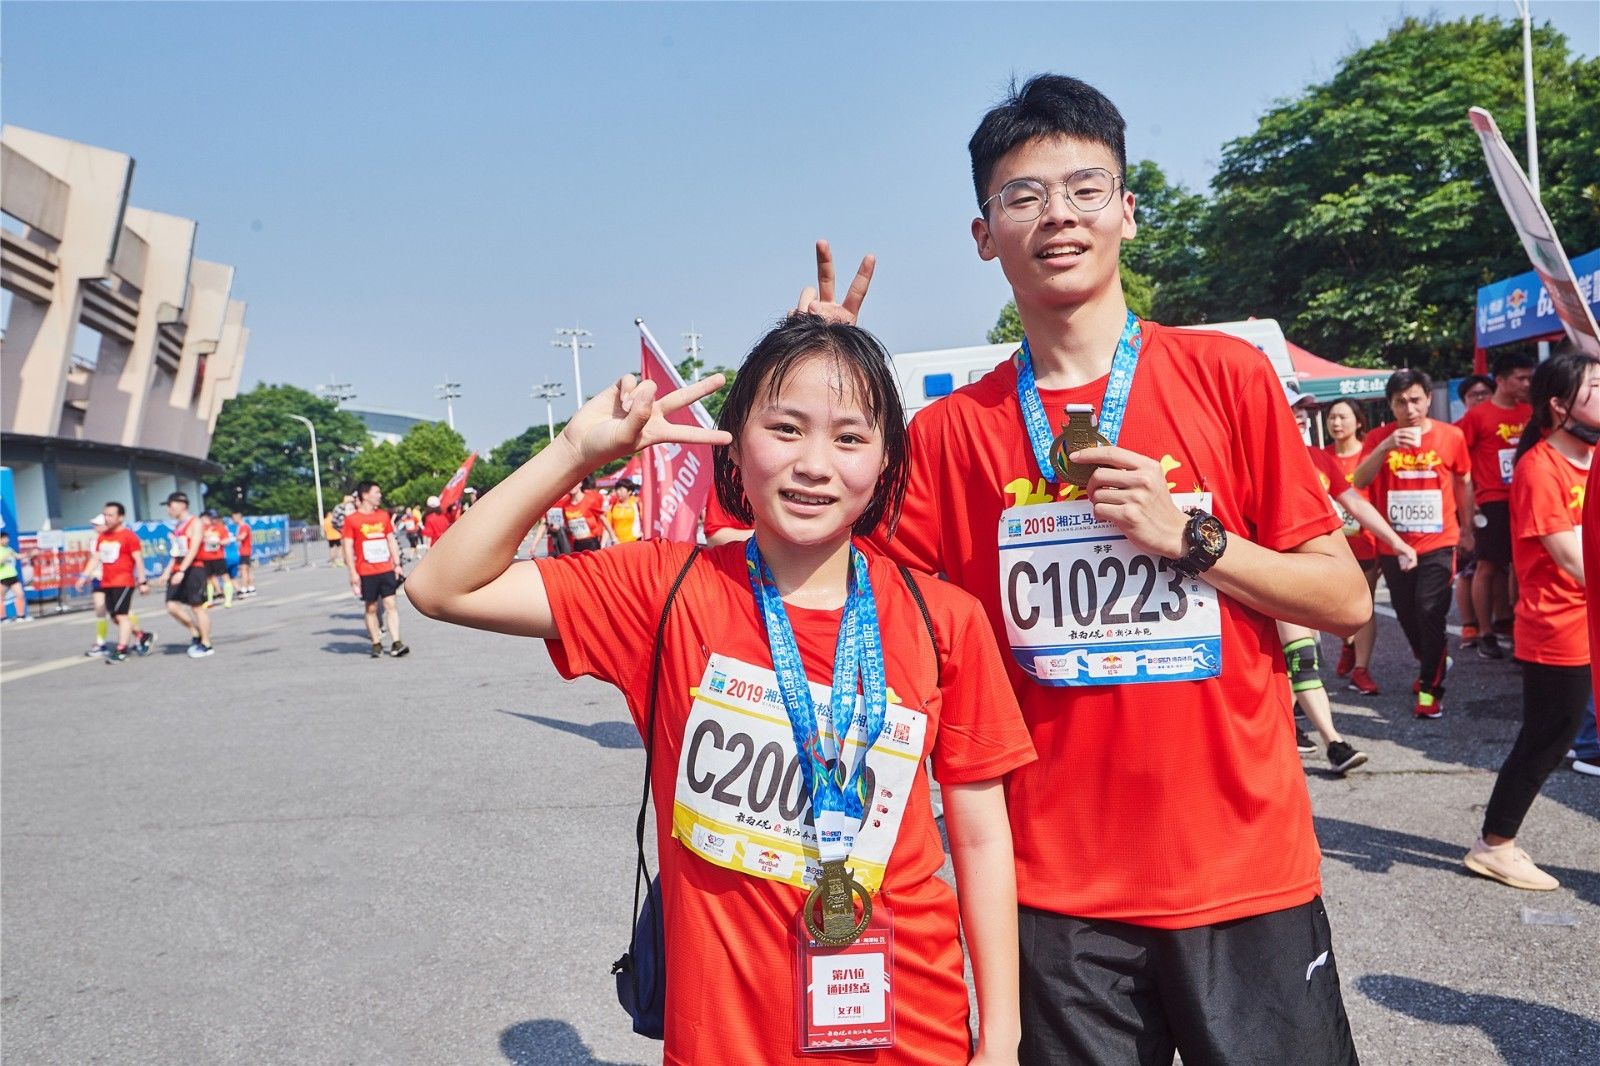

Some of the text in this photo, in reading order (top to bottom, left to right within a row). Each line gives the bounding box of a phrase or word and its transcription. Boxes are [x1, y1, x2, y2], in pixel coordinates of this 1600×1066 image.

[1339, 378, 1389, 394] 农夫山
[1390, 505, 1434, 520] C10558
[1007, 554, 1189, 630] C10223
[726, 678, 763, 703] 2019
[832, 968, 865, 981] 第八位
[827, 982, 870, 996] 通过终点
[838, 1005, 861, 1015] 女子组
